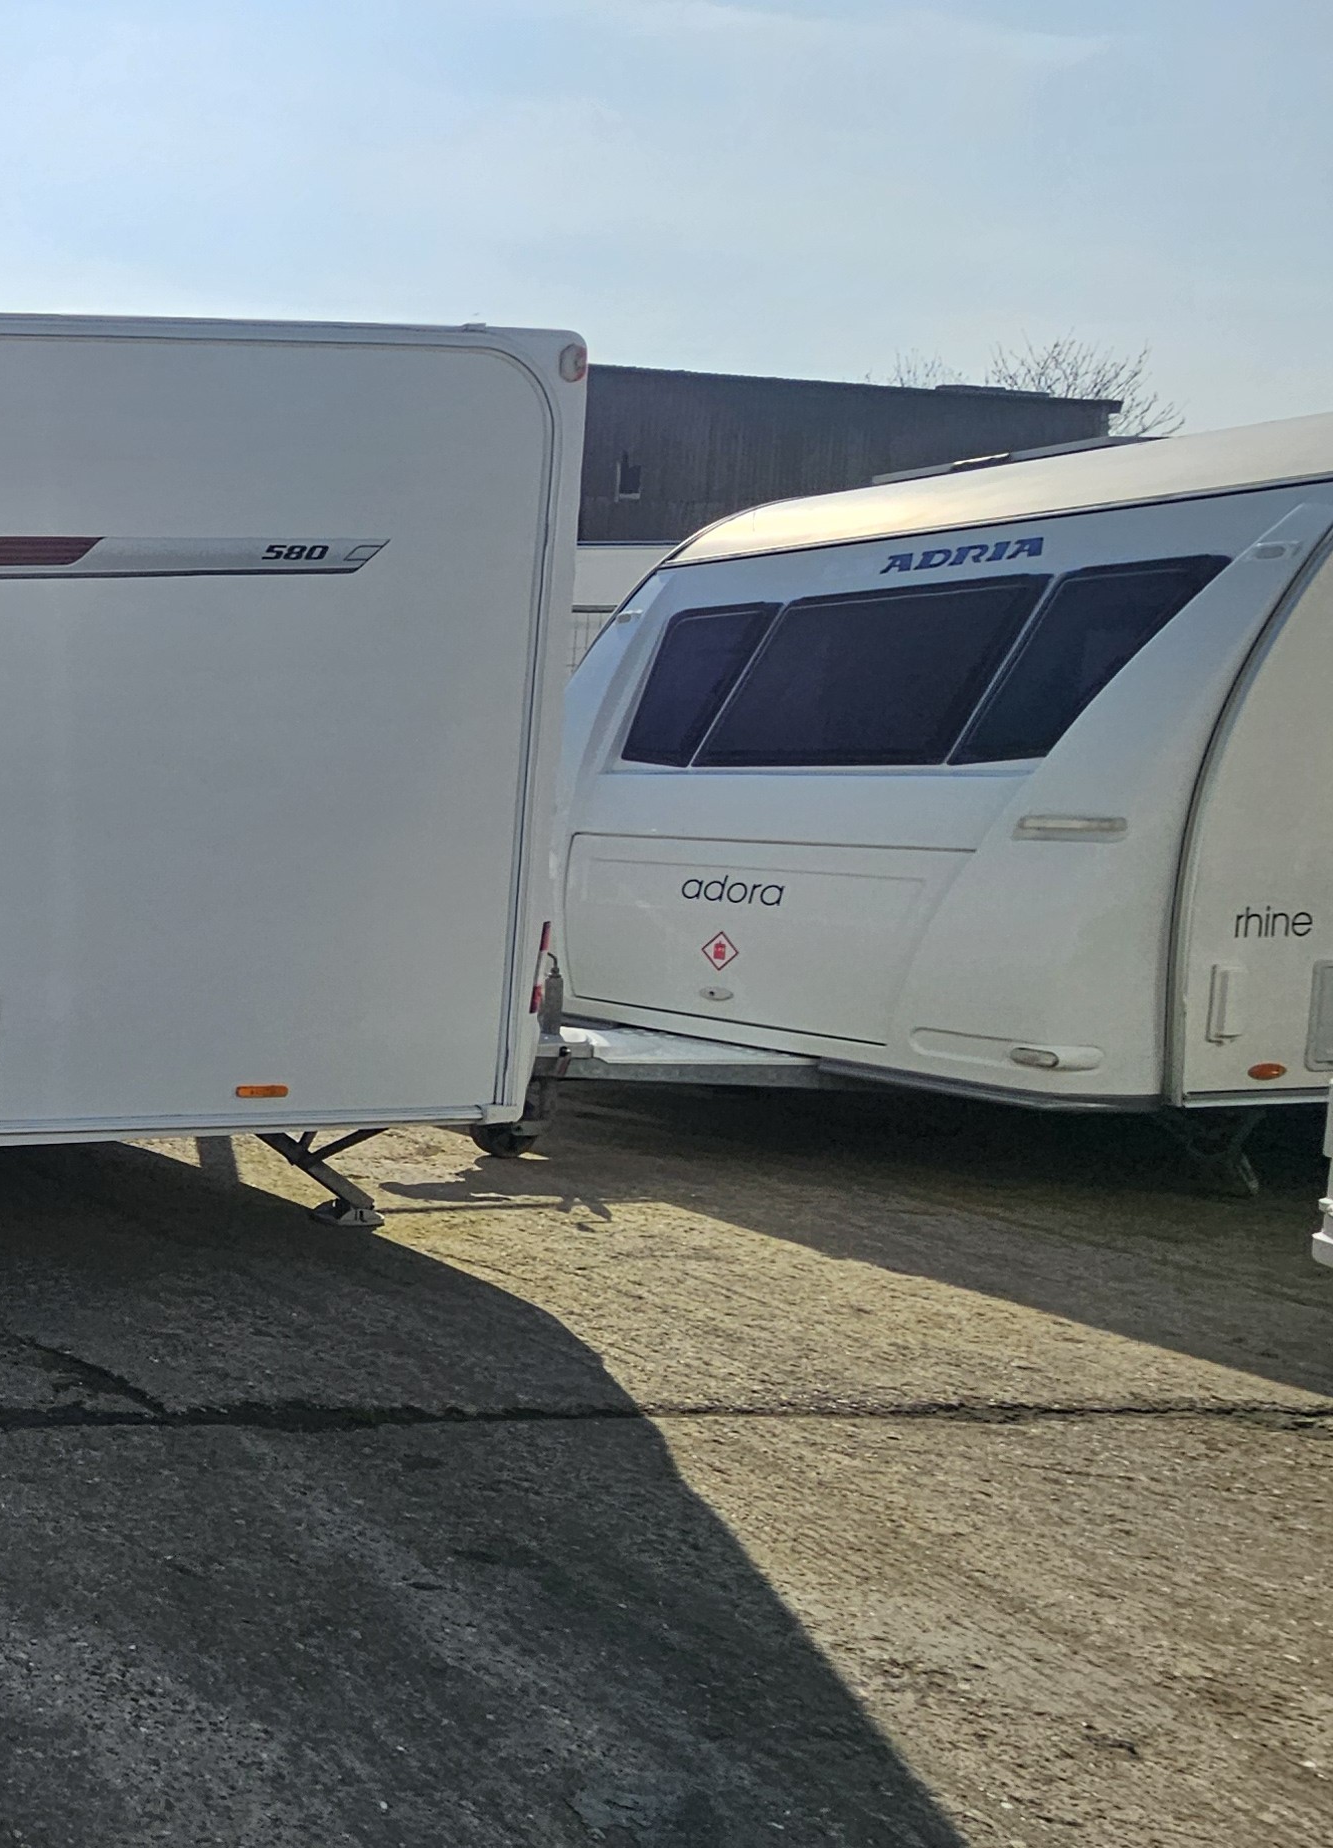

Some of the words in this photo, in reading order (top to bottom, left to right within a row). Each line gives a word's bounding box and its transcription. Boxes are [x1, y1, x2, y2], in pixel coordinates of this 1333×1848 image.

[261, 544, 329, 560] 580
[879, 537, 1044, 575] ADRIA
[681, 874, 785, 906] adora
[1234, 905, 1313, 938] rhine
